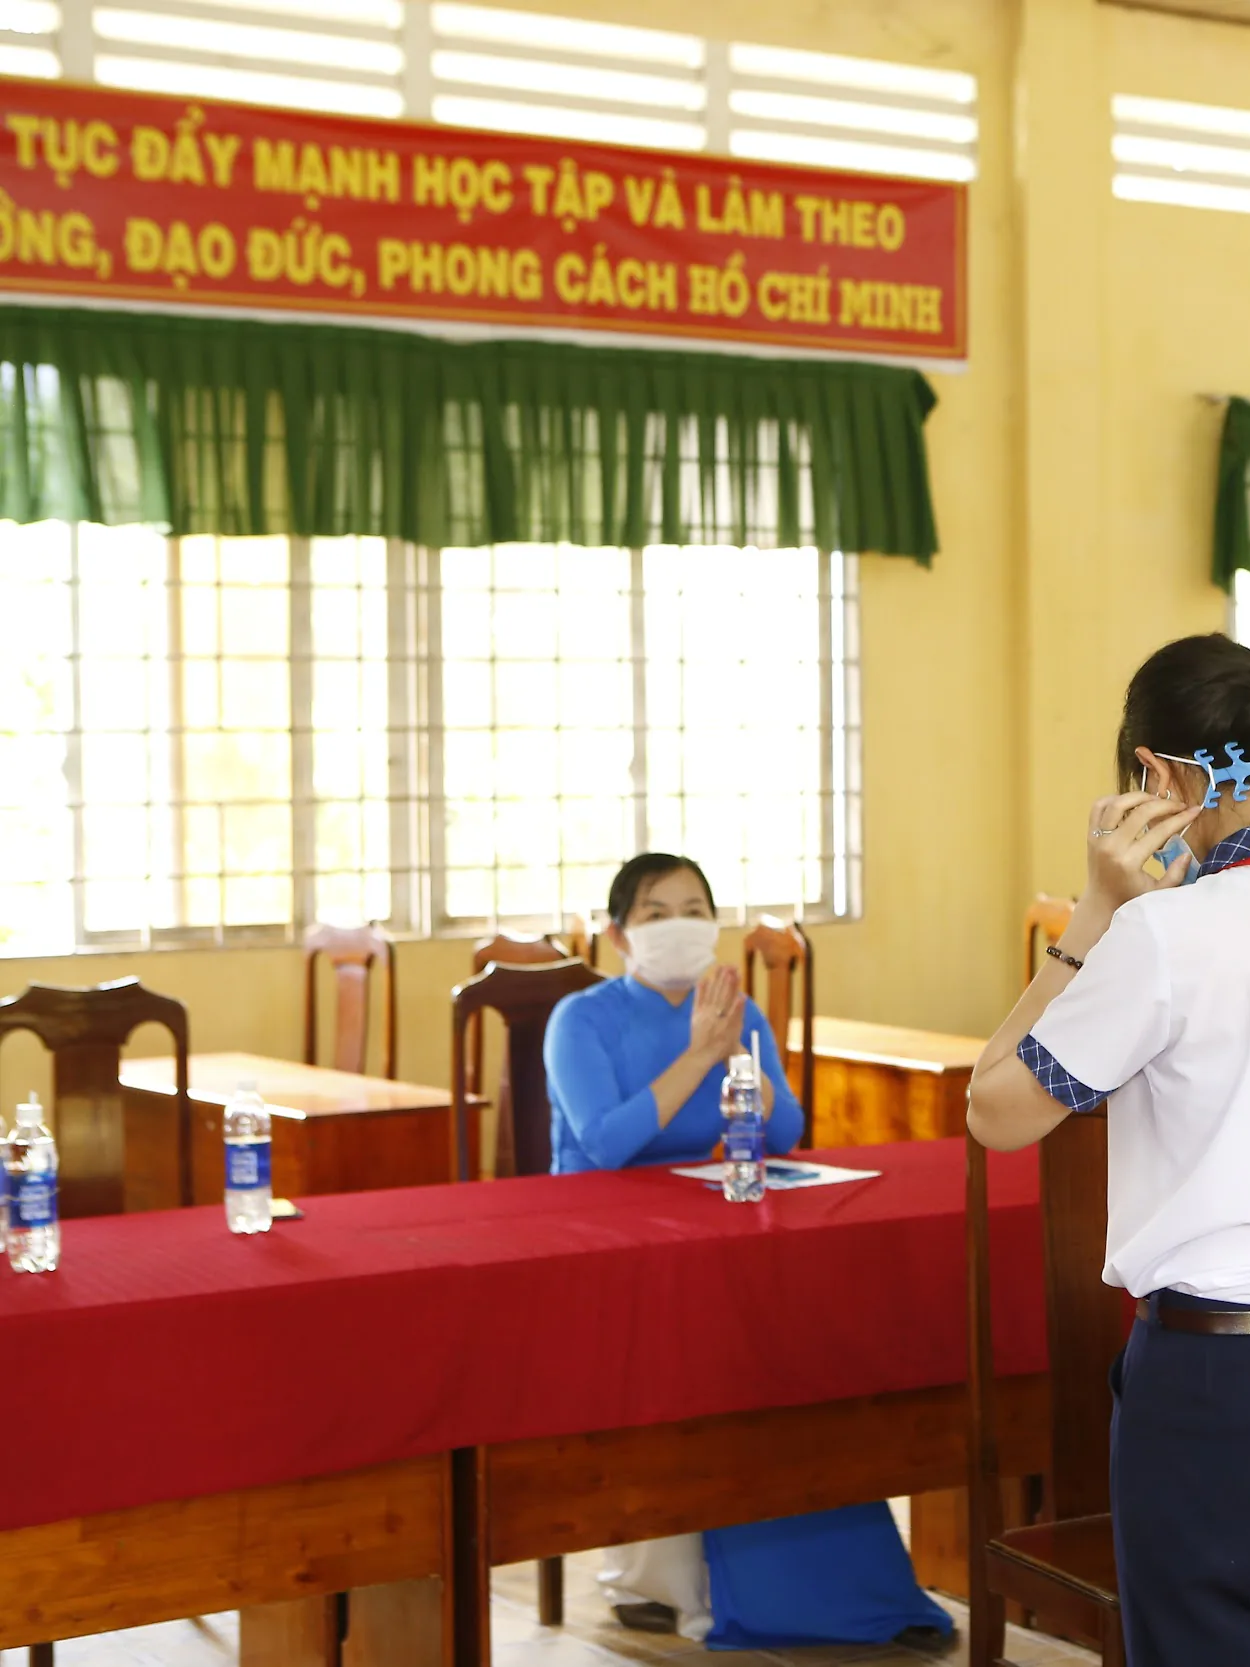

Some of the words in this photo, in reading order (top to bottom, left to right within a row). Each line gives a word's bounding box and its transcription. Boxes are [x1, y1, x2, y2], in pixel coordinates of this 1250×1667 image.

[5, 113, 119, 189] TỤC
[252, 138, 399, 210] MẠNH
[414, 154, 512, 223] HỌC
[794, 195, 905, 251] THEO
[125, 217, 236, 291] ĐẠO
[377, 238, 543, 301] PHONG
[838, 281, 943, 333] MINH
